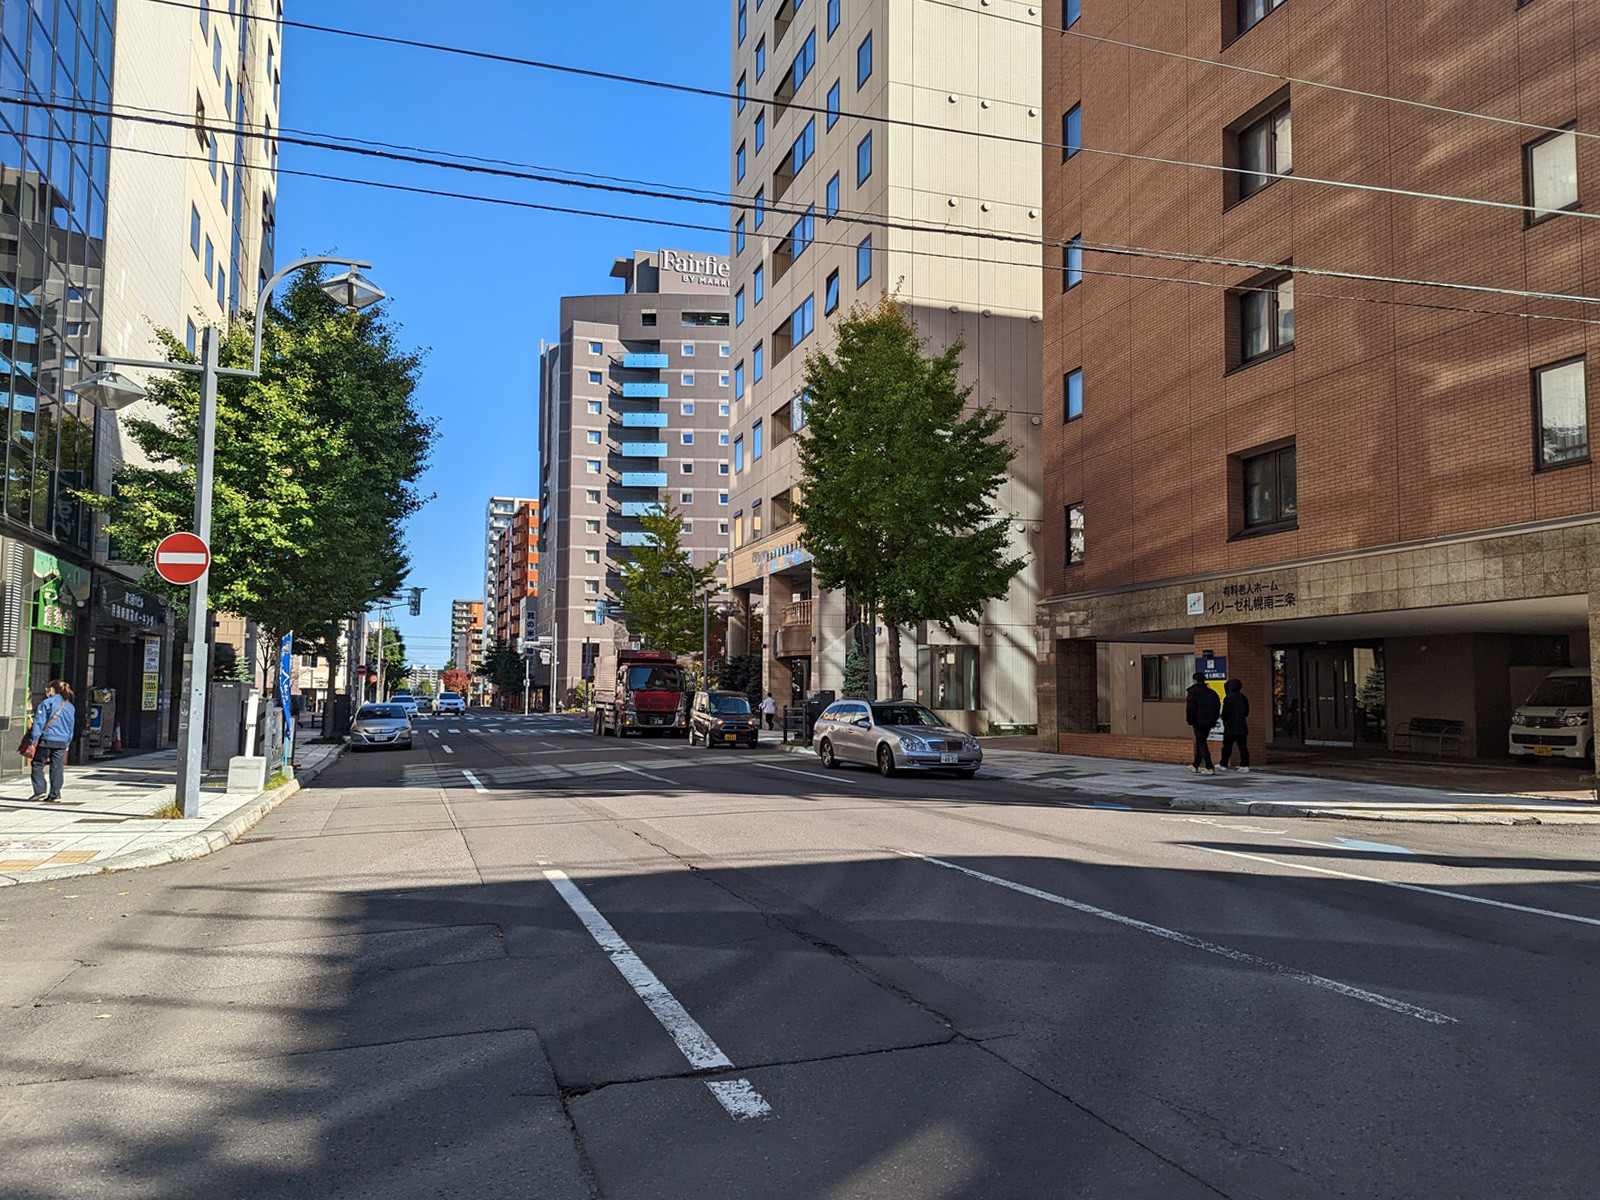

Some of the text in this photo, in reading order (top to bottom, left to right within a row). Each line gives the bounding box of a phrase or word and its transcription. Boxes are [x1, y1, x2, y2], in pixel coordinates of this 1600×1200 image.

[682, 275, 696, 283] BY
[1223, 580, 1278, 597] 有料老人ホーム
[1208, 592, 1296, 615] イリーゼ札幌南三条
